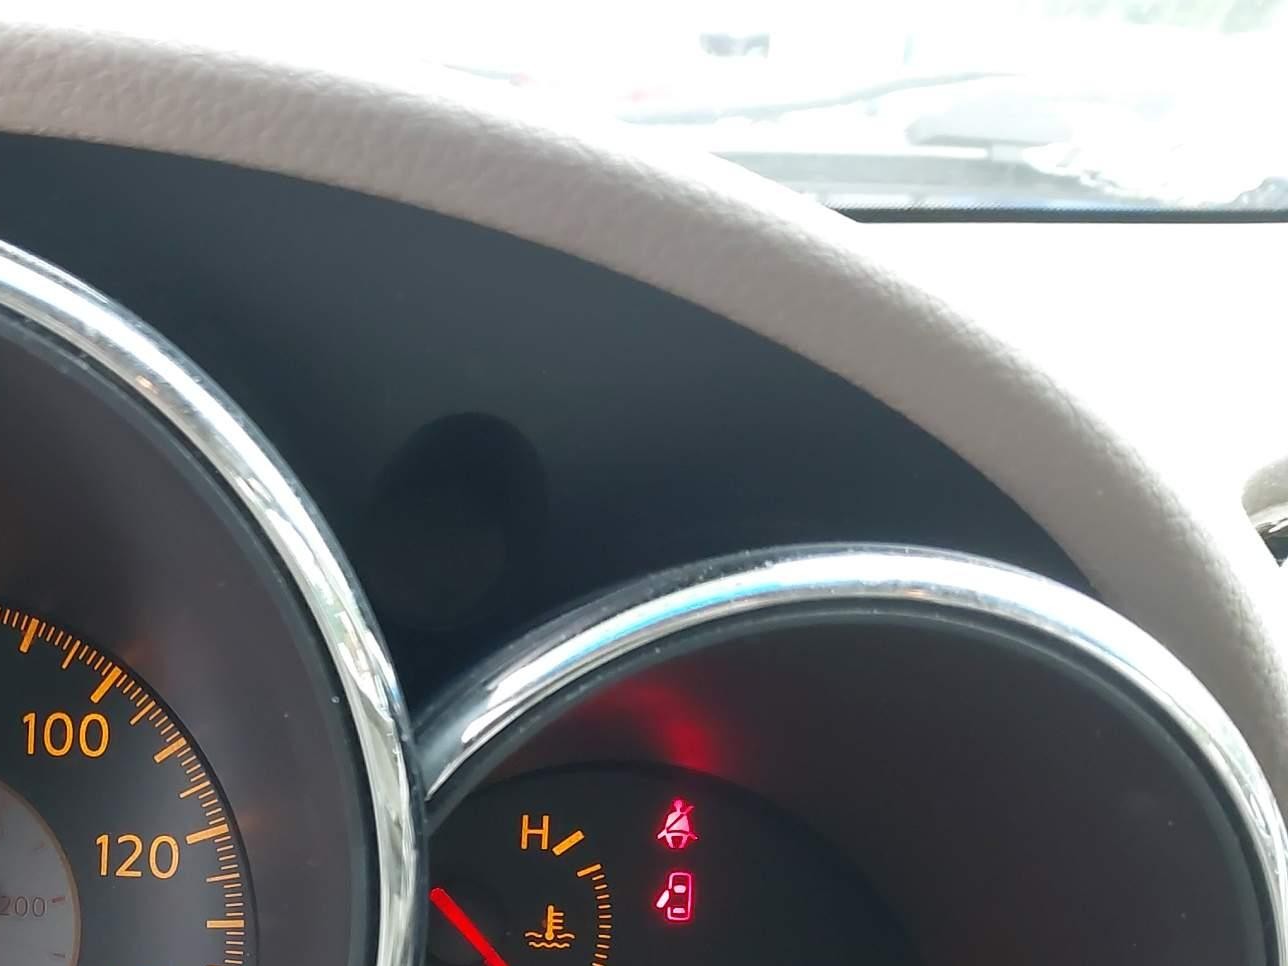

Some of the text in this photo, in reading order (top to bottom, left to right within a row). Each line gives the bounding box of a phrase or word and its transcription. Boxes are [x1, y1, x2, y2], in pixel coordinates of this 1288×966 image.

[23, 712, 110, 758] 100
[520, 815, 550, 850] H
[95, 834, 180, 879] 120
